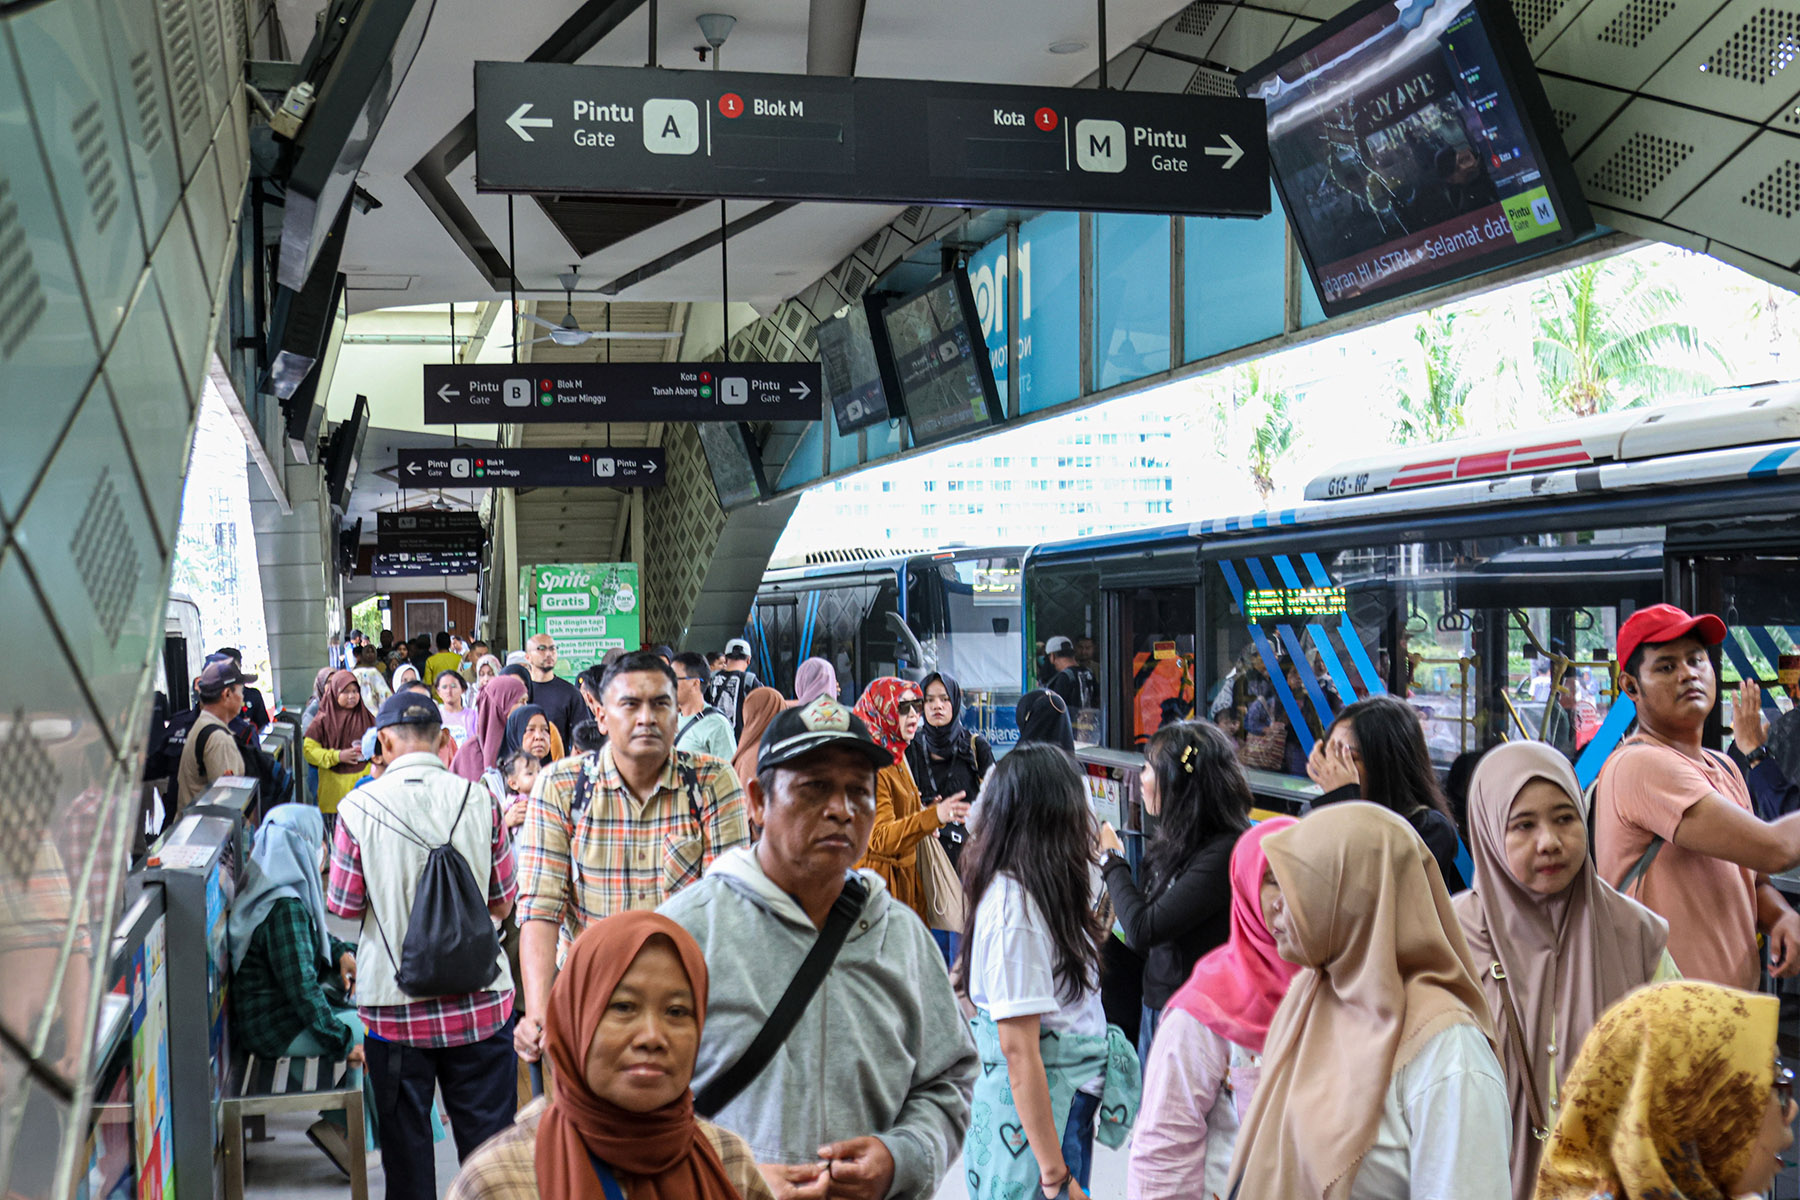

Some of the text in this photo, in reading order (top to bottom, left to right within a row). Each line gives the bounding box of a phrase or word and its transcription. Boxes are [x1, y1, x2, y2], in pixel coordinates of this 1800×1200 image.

[573, 100, 634, 123] Pintu
[728, 99, 804, 118] 1 Blok M
[993, 109, 1049, 127] Kota 1
[660, 114, 681, 139] A
[573, 129, 615, 148] Gate
[1133, 126, 1187, 149] Pintu
[1089, 134, 1112, 159] M
[1151, 154, 1188, 173] Gate
[1508, 205, 1531, 221] Pintu
[1536, 204, 1550, 220] M
[1513, 219, 1530, 232] Gate
[1356, 262, 1373, 282] HI
[1373, 248, 1415, 278] ASTRA
[1424, 224, 1483, 260] Selamat
[1483, 214, 1513, 240] dat
[680, 372, 697, 381] Kota
[469, 381, 499, 392] Pintu
[557, 380, 573, 389] Blok
[575, 380, 582, 389] M
[751, 379, 780, 391] Pintu
[512, 387, 521, 399] B
[652, 386, 674, 396] Tanah
[674, 386, 698, 398] Abang
[730, 385, 739, 397] L
[469, 395, 490, 405] Gate
[557, 394, 577, 403] Pasar
[578, 395, 606, 406] Minggu
[760, 394, 780, 403] Gate
[427, 460, 449, 468] Pintu
[457, 464, 463, 472] C
[602, 463, 609, 472] K
[616, 460, 637, 468] Pintu
[1328, 476, 1347, 496] G15
[539, 571, 590, 592] Sprite
[546, 597, 584, 607] Gratis
[563, 618, 587, 626] dingin
[588, 618, 604, 626] tapi
